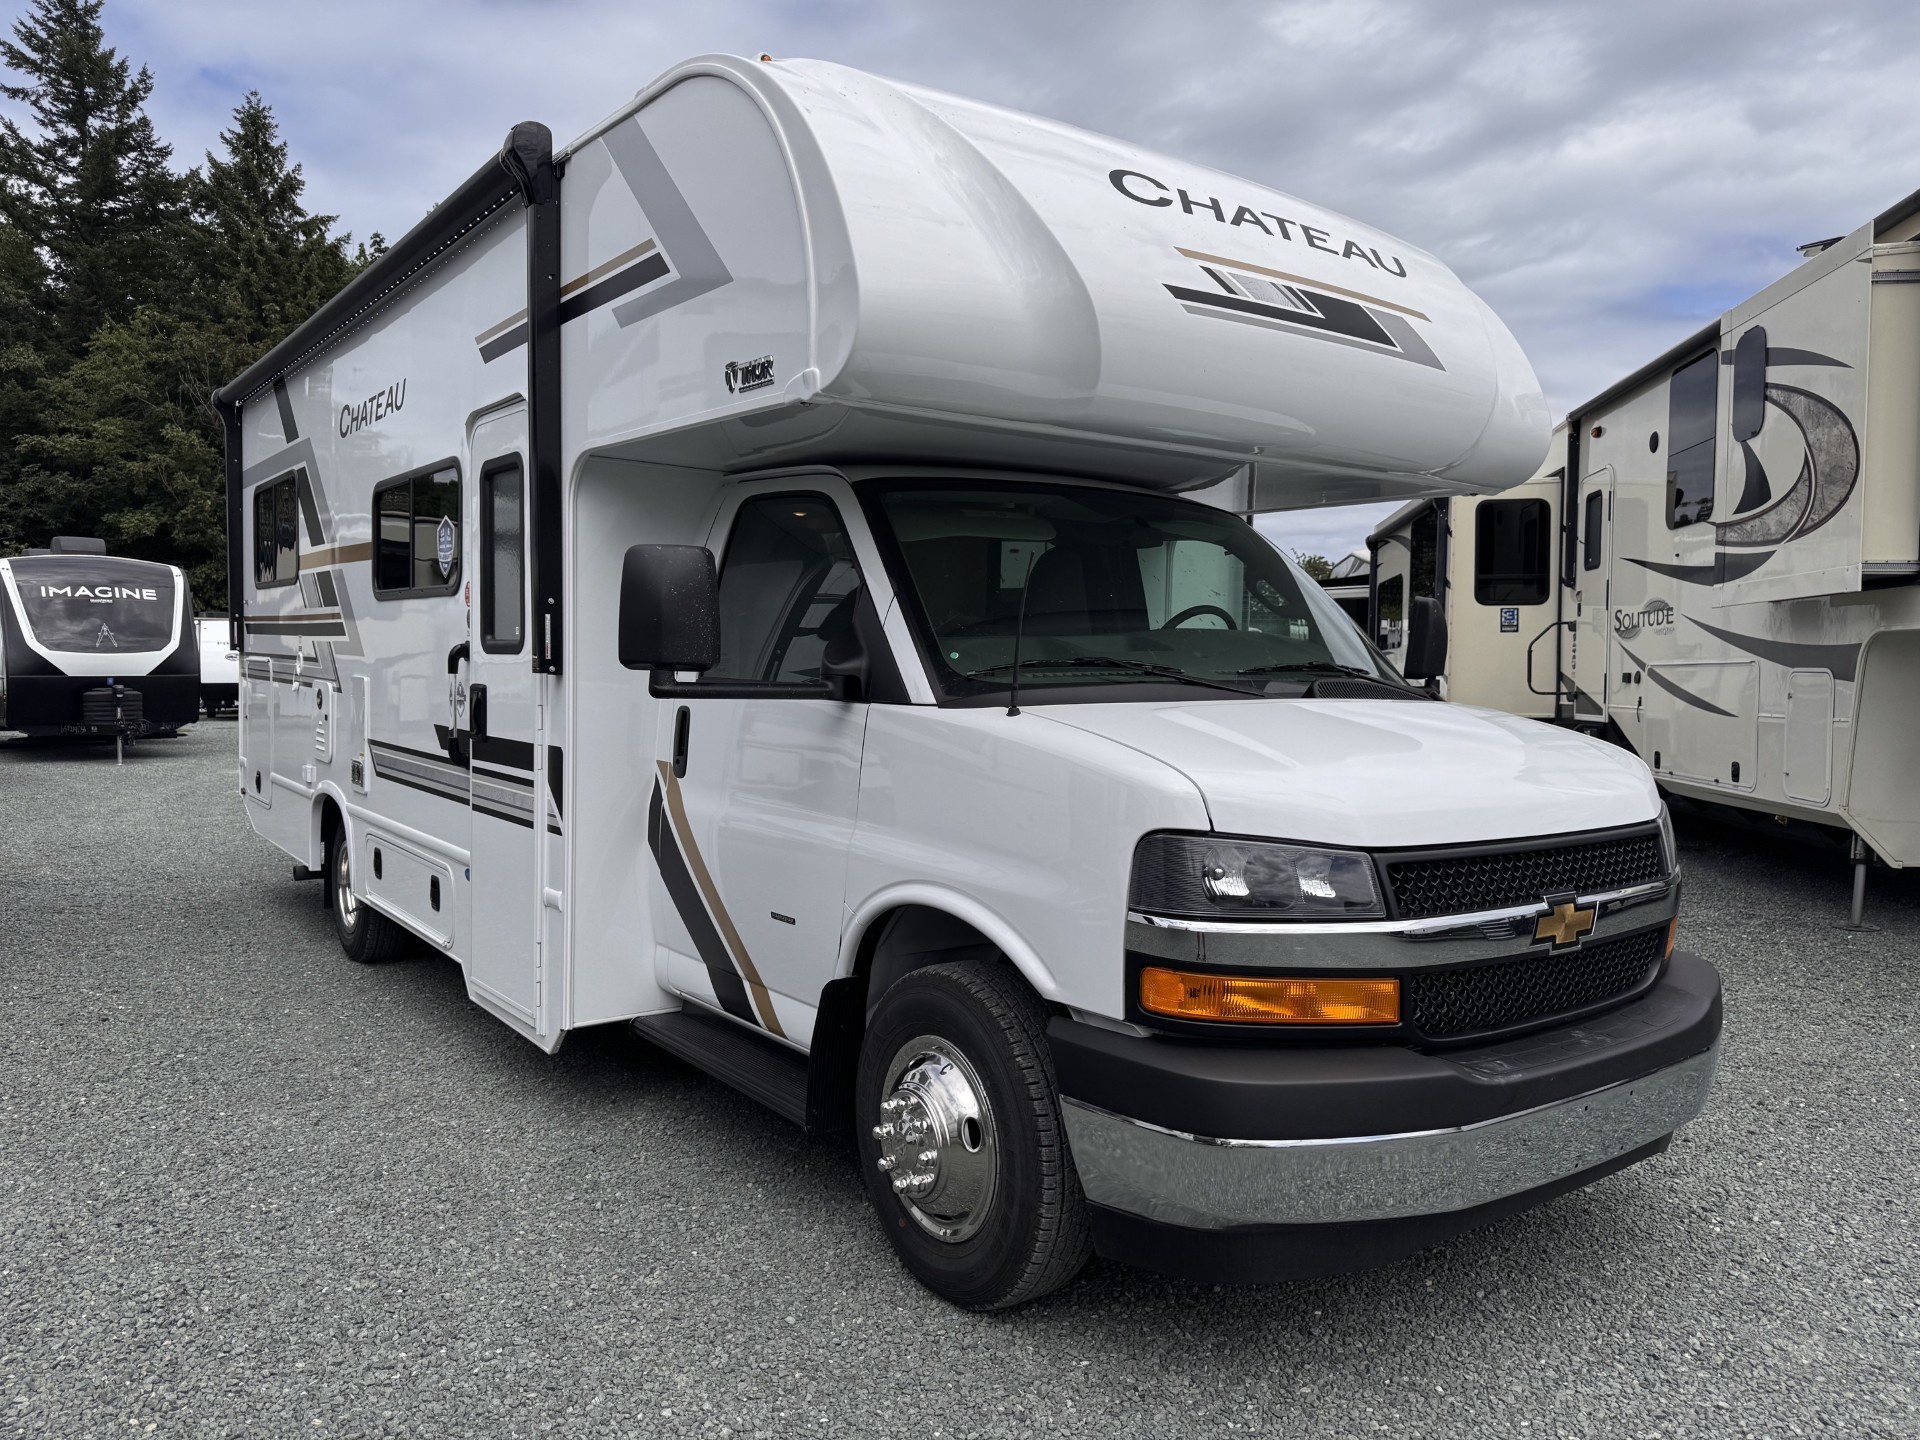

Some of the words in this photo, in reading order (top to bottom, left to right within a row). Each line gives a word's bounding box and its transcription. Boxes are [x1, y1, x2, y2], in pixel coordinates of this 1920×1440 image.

[1109, 169, 1407, 278] CHATEAU
[340, 377, 407, 439] CHATEAU
[40, 585, 158, 601] IMAGINE
[1614, 606, 1674, 631] SOLITUDE
